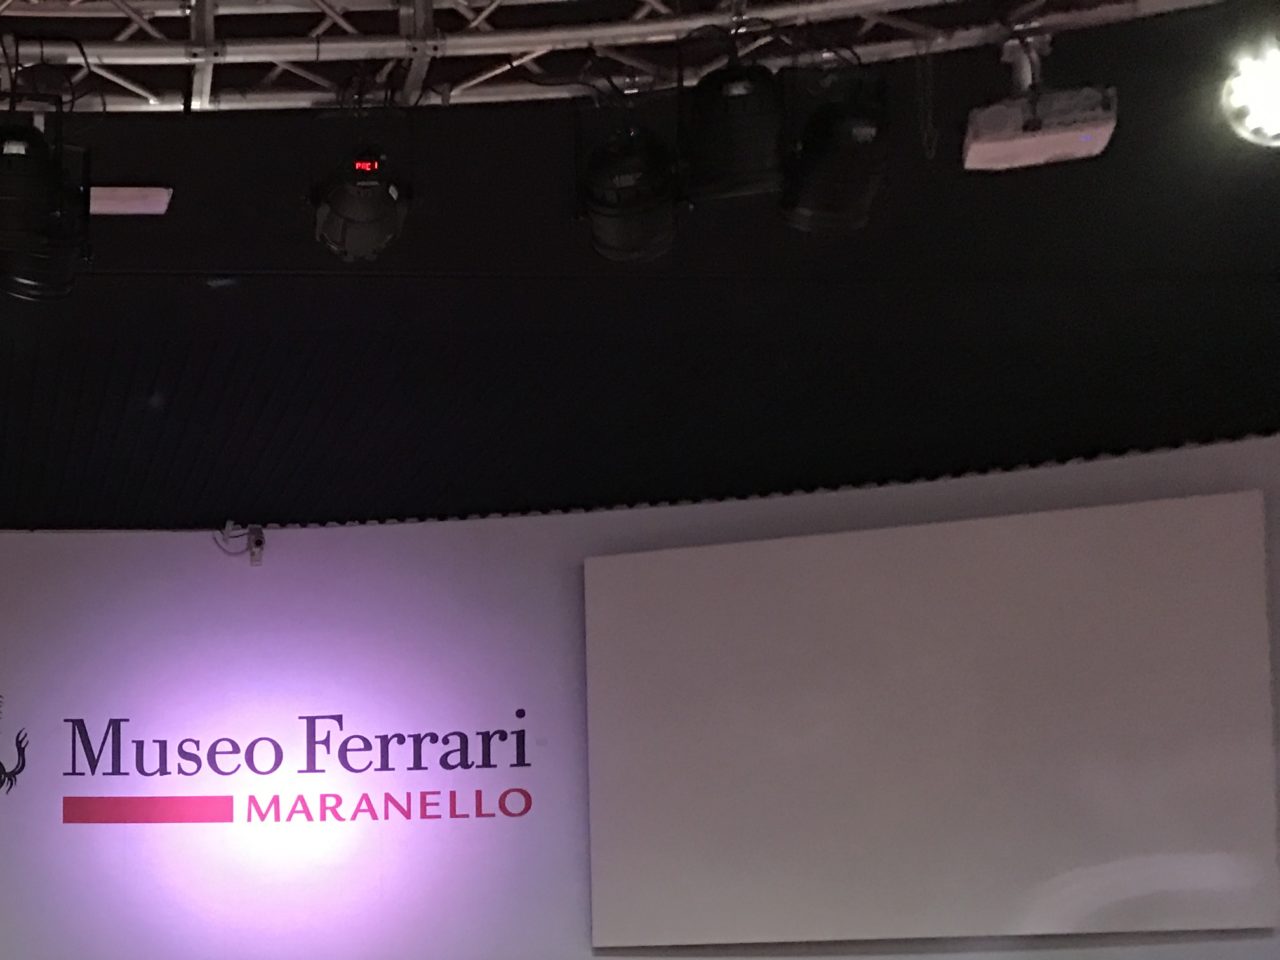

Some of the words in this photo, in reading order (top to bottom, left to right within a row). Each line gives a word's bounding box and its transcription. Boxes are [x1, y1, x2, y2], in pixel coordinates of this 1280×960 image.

[62, 717, 285, 778] Museo
[297, 708, 532, 774] Ferrari
[245, 787, 533, 823] MARANELLO
